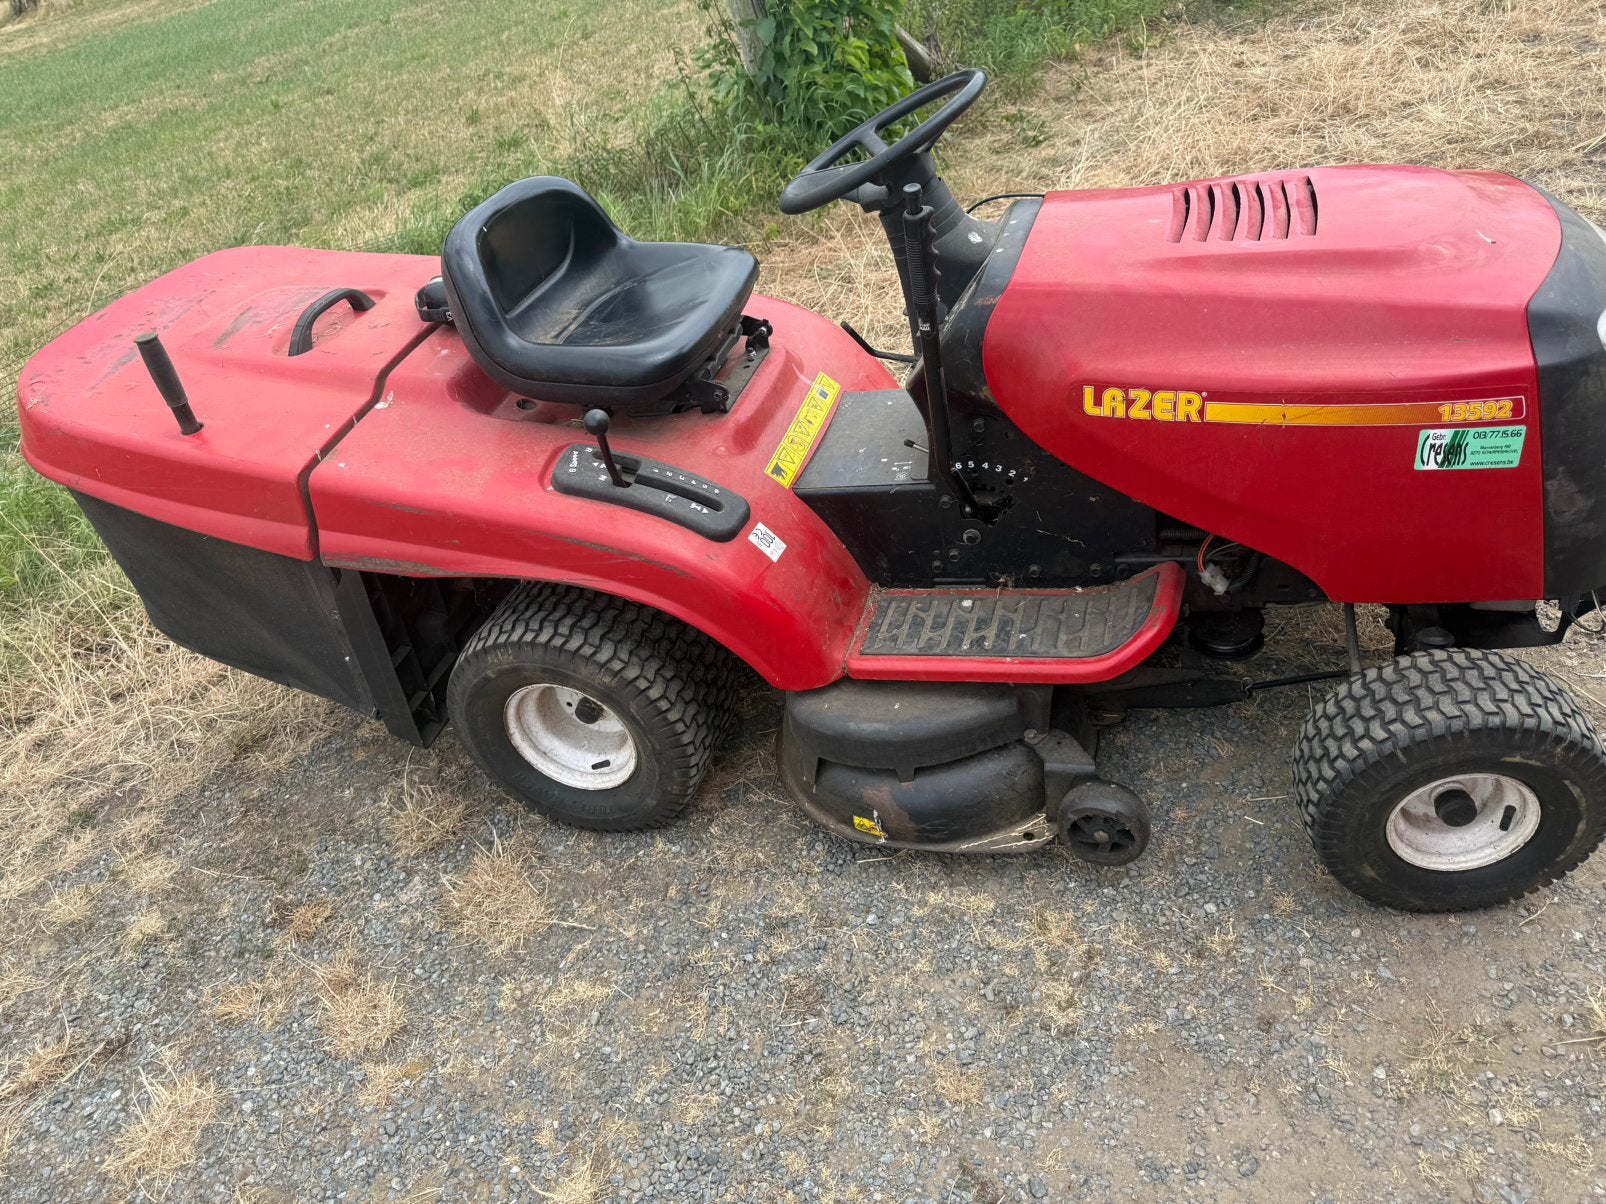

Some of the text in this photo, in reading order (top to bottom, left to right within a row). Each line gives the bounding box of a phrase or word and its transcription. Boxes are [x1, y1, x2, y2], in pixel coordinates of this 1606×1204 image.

[1083, 385, 1202, 422] LAZER
[1438, 400, 1513, 421] 13592
[955, 462, 963, 470] 6
[995, 464, 1002, 472] 3
[1008, 469, 1016, 477] 2
